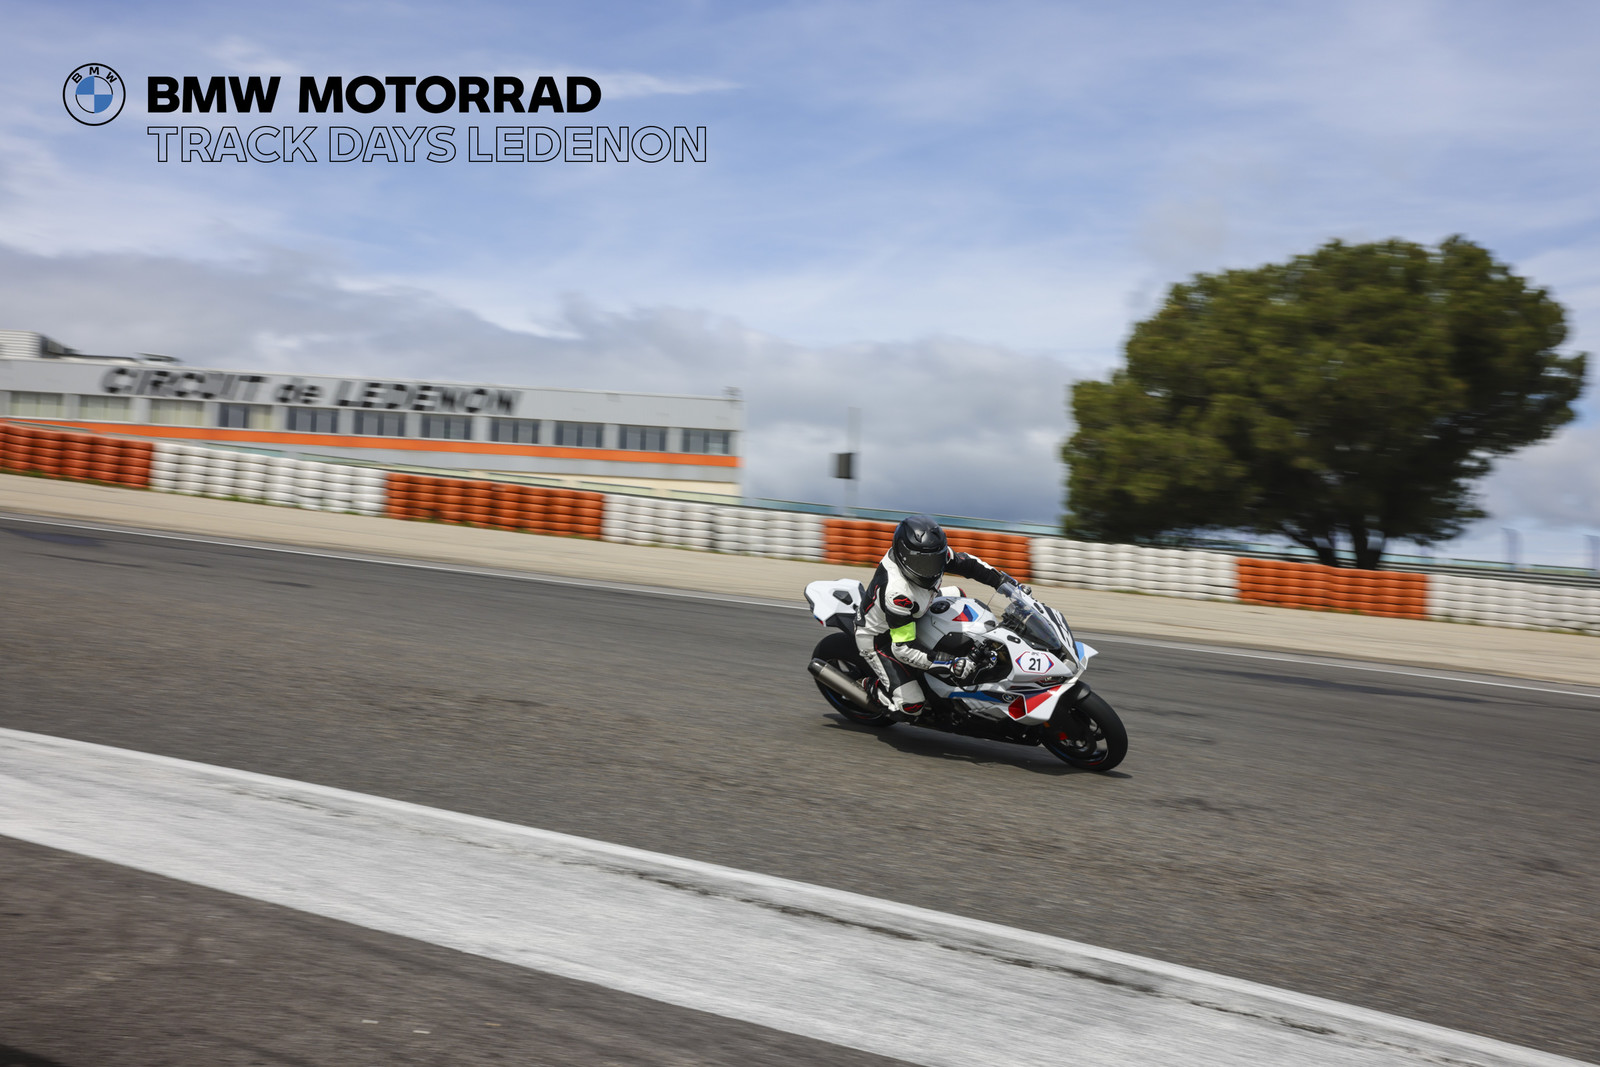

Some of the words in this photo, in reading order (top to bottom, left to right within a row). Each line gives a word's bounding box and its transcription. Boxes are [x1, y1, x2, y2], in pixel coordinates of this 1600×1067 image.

[101, 366, 268, 400] CIRCUIT
[272, 376, 322, 404] de
[336, 379, 524, 415] LEDENON
[1028, 657, 1041, 671] 21
